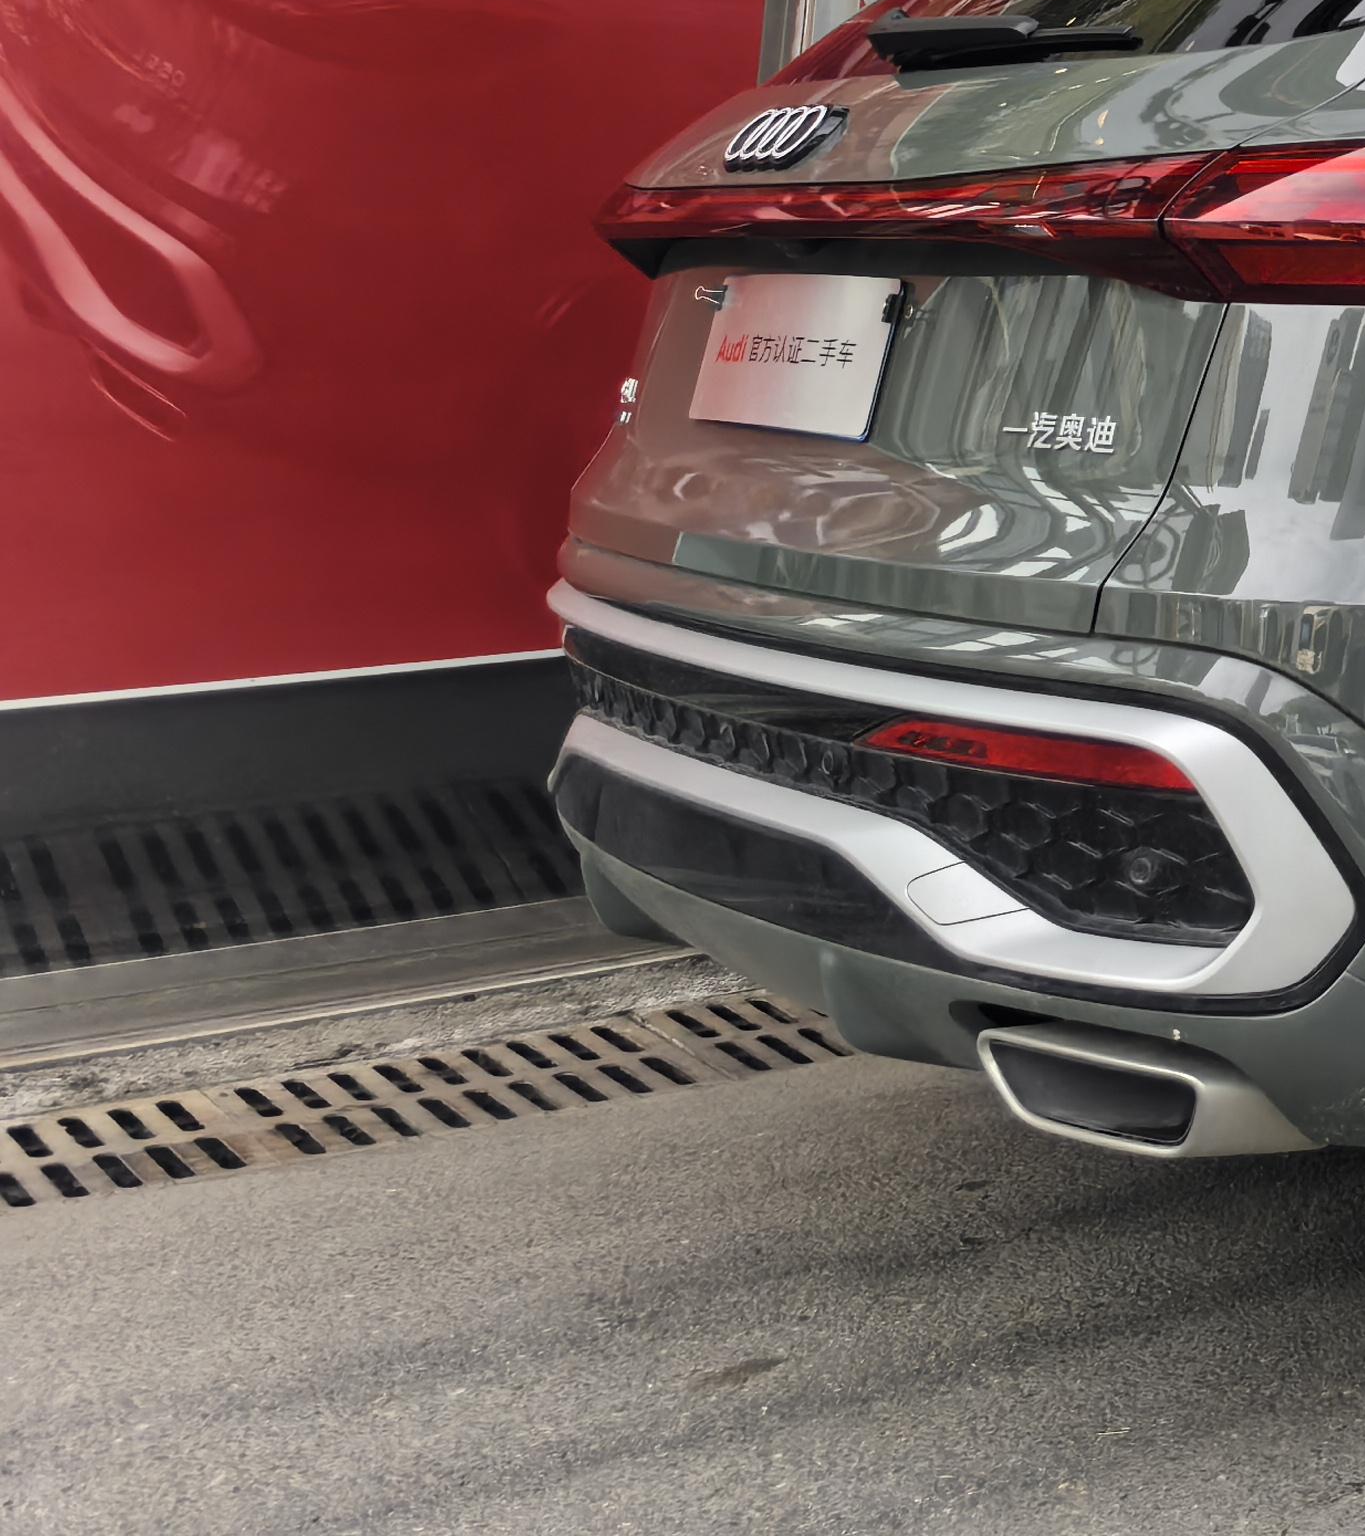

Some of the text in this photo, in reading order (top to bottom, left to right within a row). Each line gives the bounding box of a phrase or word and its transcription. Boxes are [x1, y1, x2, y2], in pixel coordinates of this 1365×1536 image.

[716, 335, 857, 368] Audi 官方认证二手车
[1002, 411, 1117, 454] 一汽奥迪
